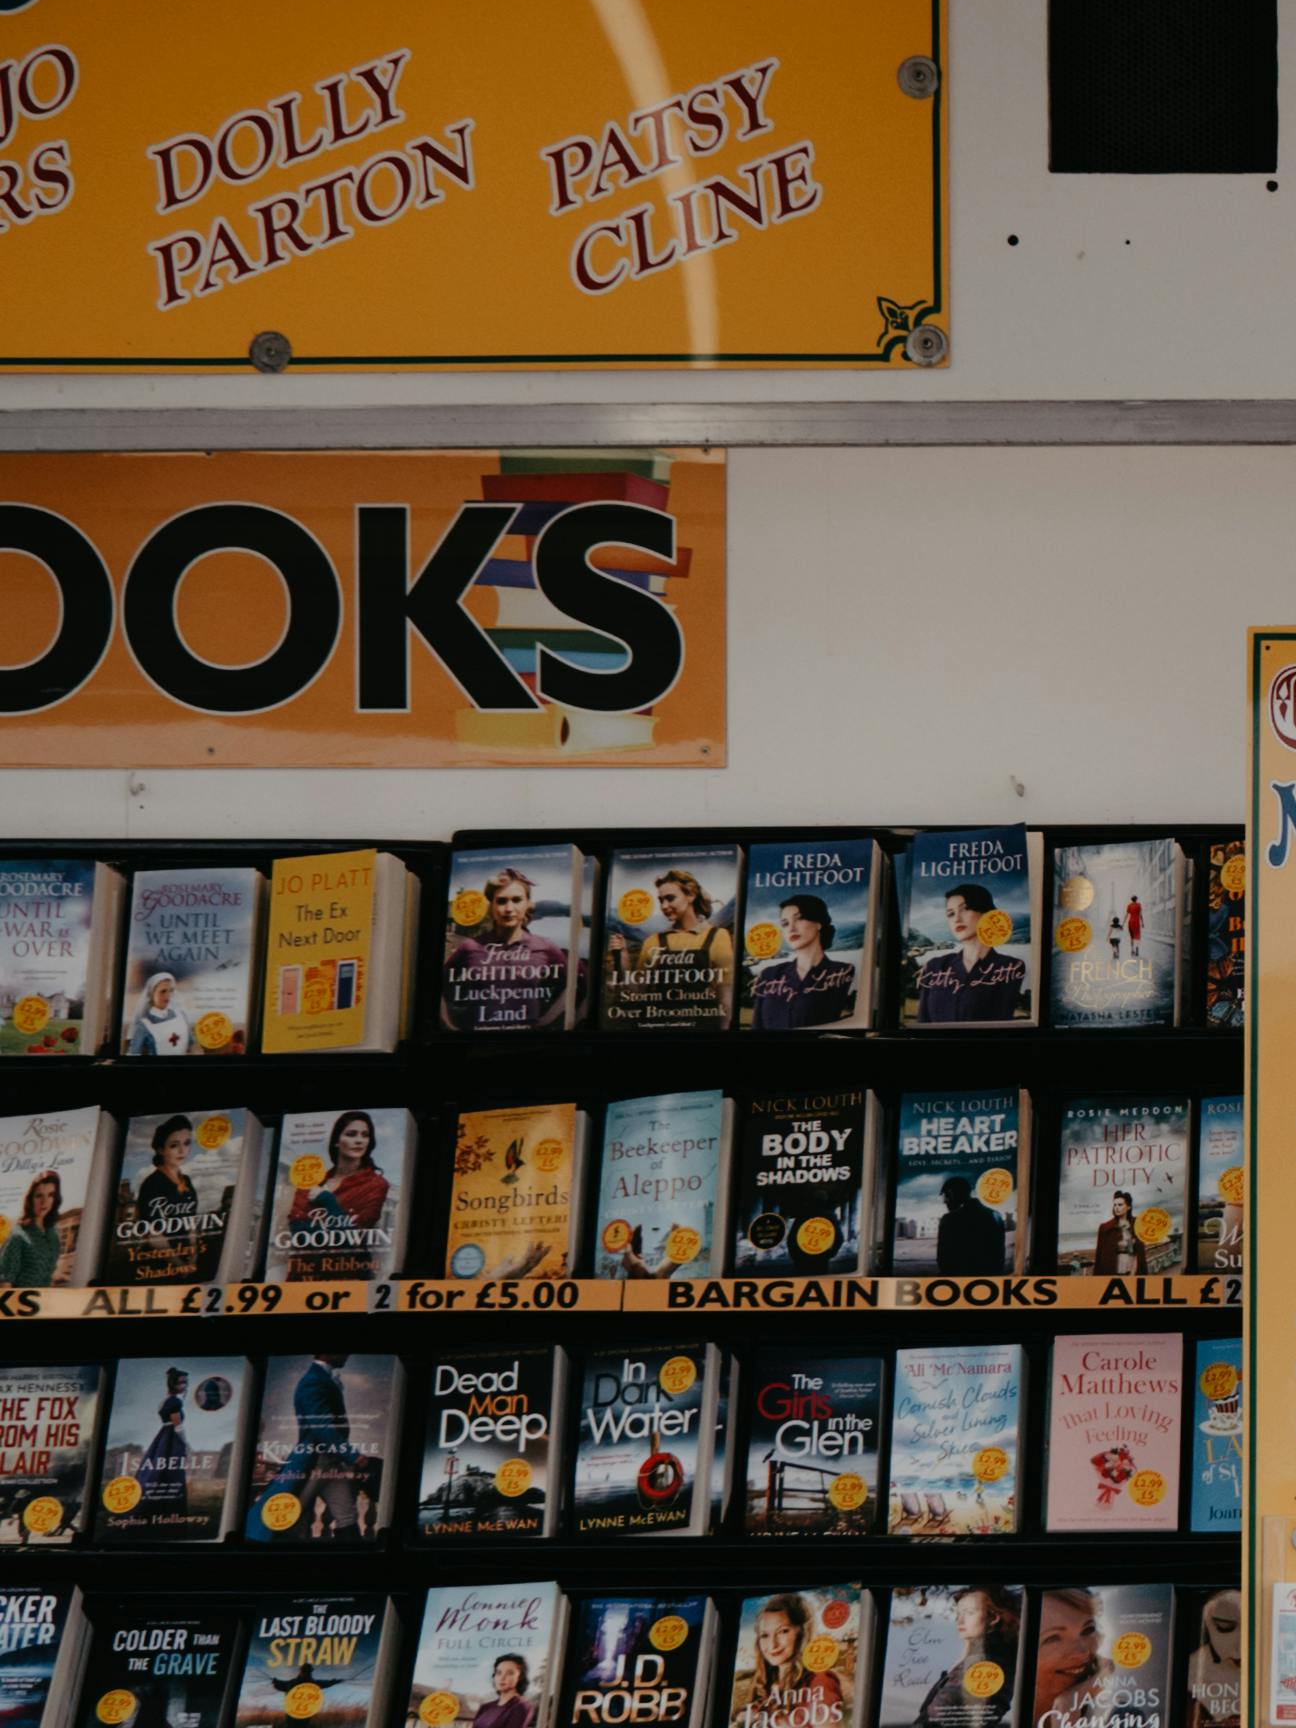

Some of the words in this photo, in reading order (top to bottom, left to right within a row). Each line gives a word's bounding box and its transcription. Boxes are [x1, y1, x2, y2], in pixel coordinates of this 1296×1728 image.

[149, 49, 410, 215] DOLLY
[539, 57, 780, 217] PATSY
[149, 120, 475, 311] PARTON
[570, 142, 823, 297] CLINE
[784, 853, 842, 871] FREDA
[948, 840, 1004, 859] FREDA
[754, 868, 864, 888] LIGHTFOOT
[920, 854, 1023, 877] LIGHTFOOT
[279, 927, 318, 948] Next
[323, 925, 361, 945] Door
[448, 964, 564, 984] LIGHTFOOT
[454, 983, 552, 1005] Luckpenny
[478, 1003, 528, 1022] Land
[920, 1114, 1006, 1136] HEART
[762, 1128, 854, 1156] BODY
[902, 1130, 1018, 1155] BREAKER
[756, 1166, 851, 1186] SHADOWS
[456, 1187, 570, 1214] Songbirds
[116, 1212, 227, 1240] GOODWIN
[274, 1228, 393, 1249] GOODWIN
[83, 1289, 168, 1315] ALL
[181, 1285, 283, 1315] £2.99
[306, 1289, 350, 1311] or
[375, 1286, 392, 1309] 2
[408, 1283, 465, 1310] for
[475, 1282, 579, 1309] £5.00
[667, 1279, 879, 1308] BARGAIN
[894, 1278, 1058, 1306] BOOKS
[1098, 1277, 1188, 1305] ALL
[1082, 1350, 1157, 1371] Carole
[434, 1362, 518, 1396] Dead
[792, 1374, 823, 1391] The
[1059, 1373, 1179, 1397] Matthews
[467, 1392, 528, 1417] Man
[757, 1382, 833, 1421] Girls
[438, 1411, 548, 1451] Deep
[775, 1419, 865, 1457] Glen
[259, 1614, 302, 1638] LAST
[306, 1613, 375, 1637] BLOODY
[266, 1637, 357, 1668] STRAW
